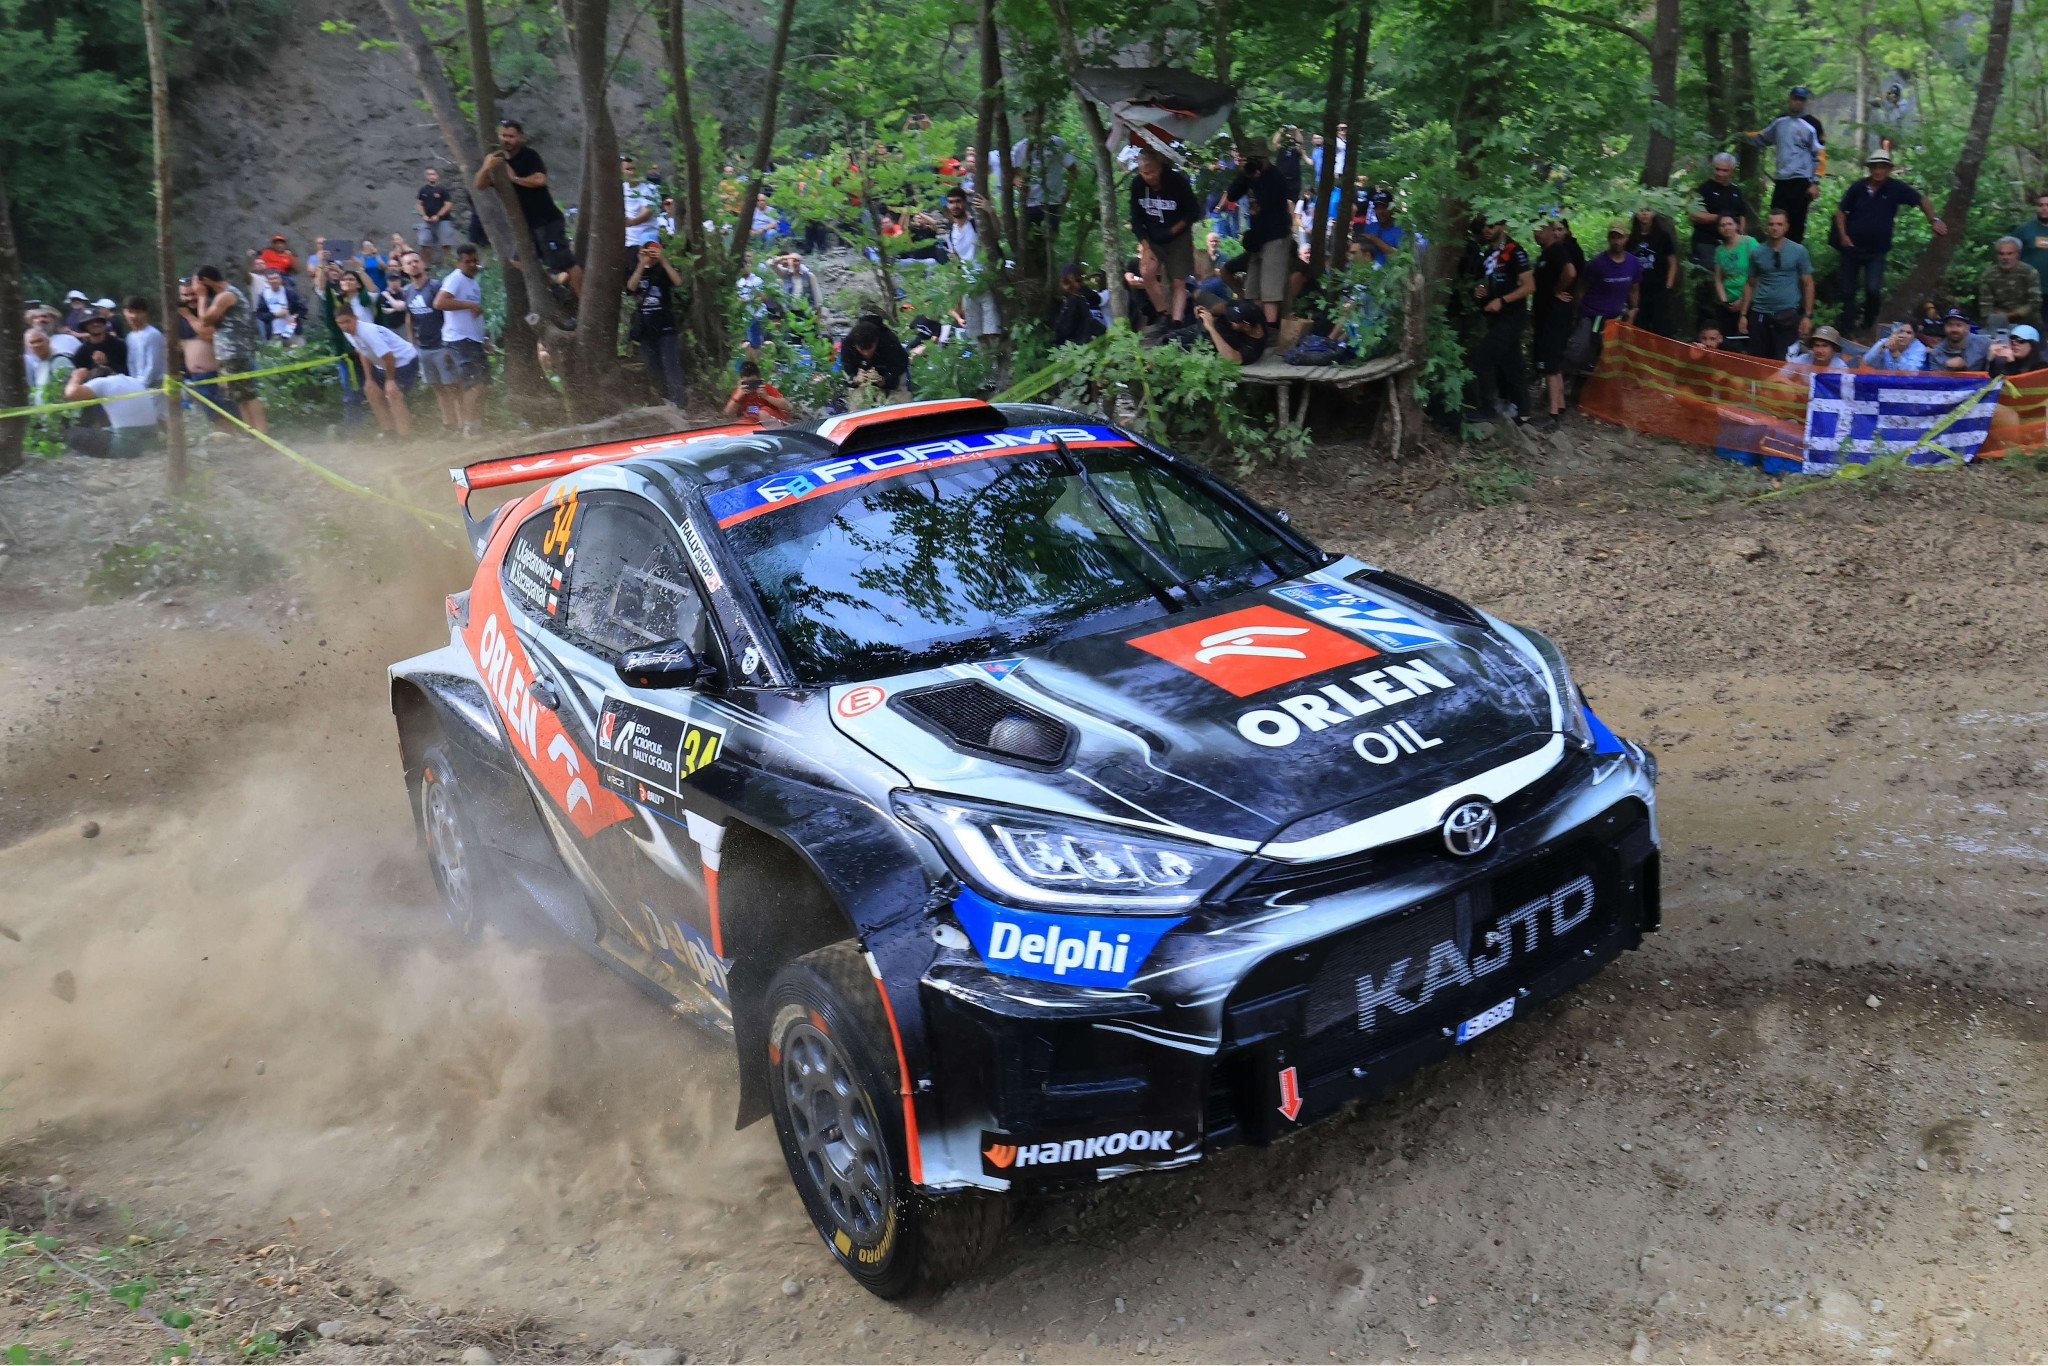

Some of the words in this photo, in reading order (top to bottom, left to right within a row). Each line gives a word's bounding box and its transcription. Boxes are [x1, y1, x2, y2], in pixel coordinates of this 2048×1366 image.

[811, 429, 1096, 483] FORUM8
[543, 484, 579, 555] 34
[480, 614, 537, 760] ORLEN
[1236, 658, 1456, 747] ORLEN
[633, 736, 663, 755] ACROPOLIS
[635, 723, 651, 736] EKO
[1353, 721, 1444, 764] OIL
[632, 749, 648, 763] RALLY
[648, 754, 657, 767] OF
[656, 758, 673, 773] GODS
[988, 921, 1130, 976] Delphi
